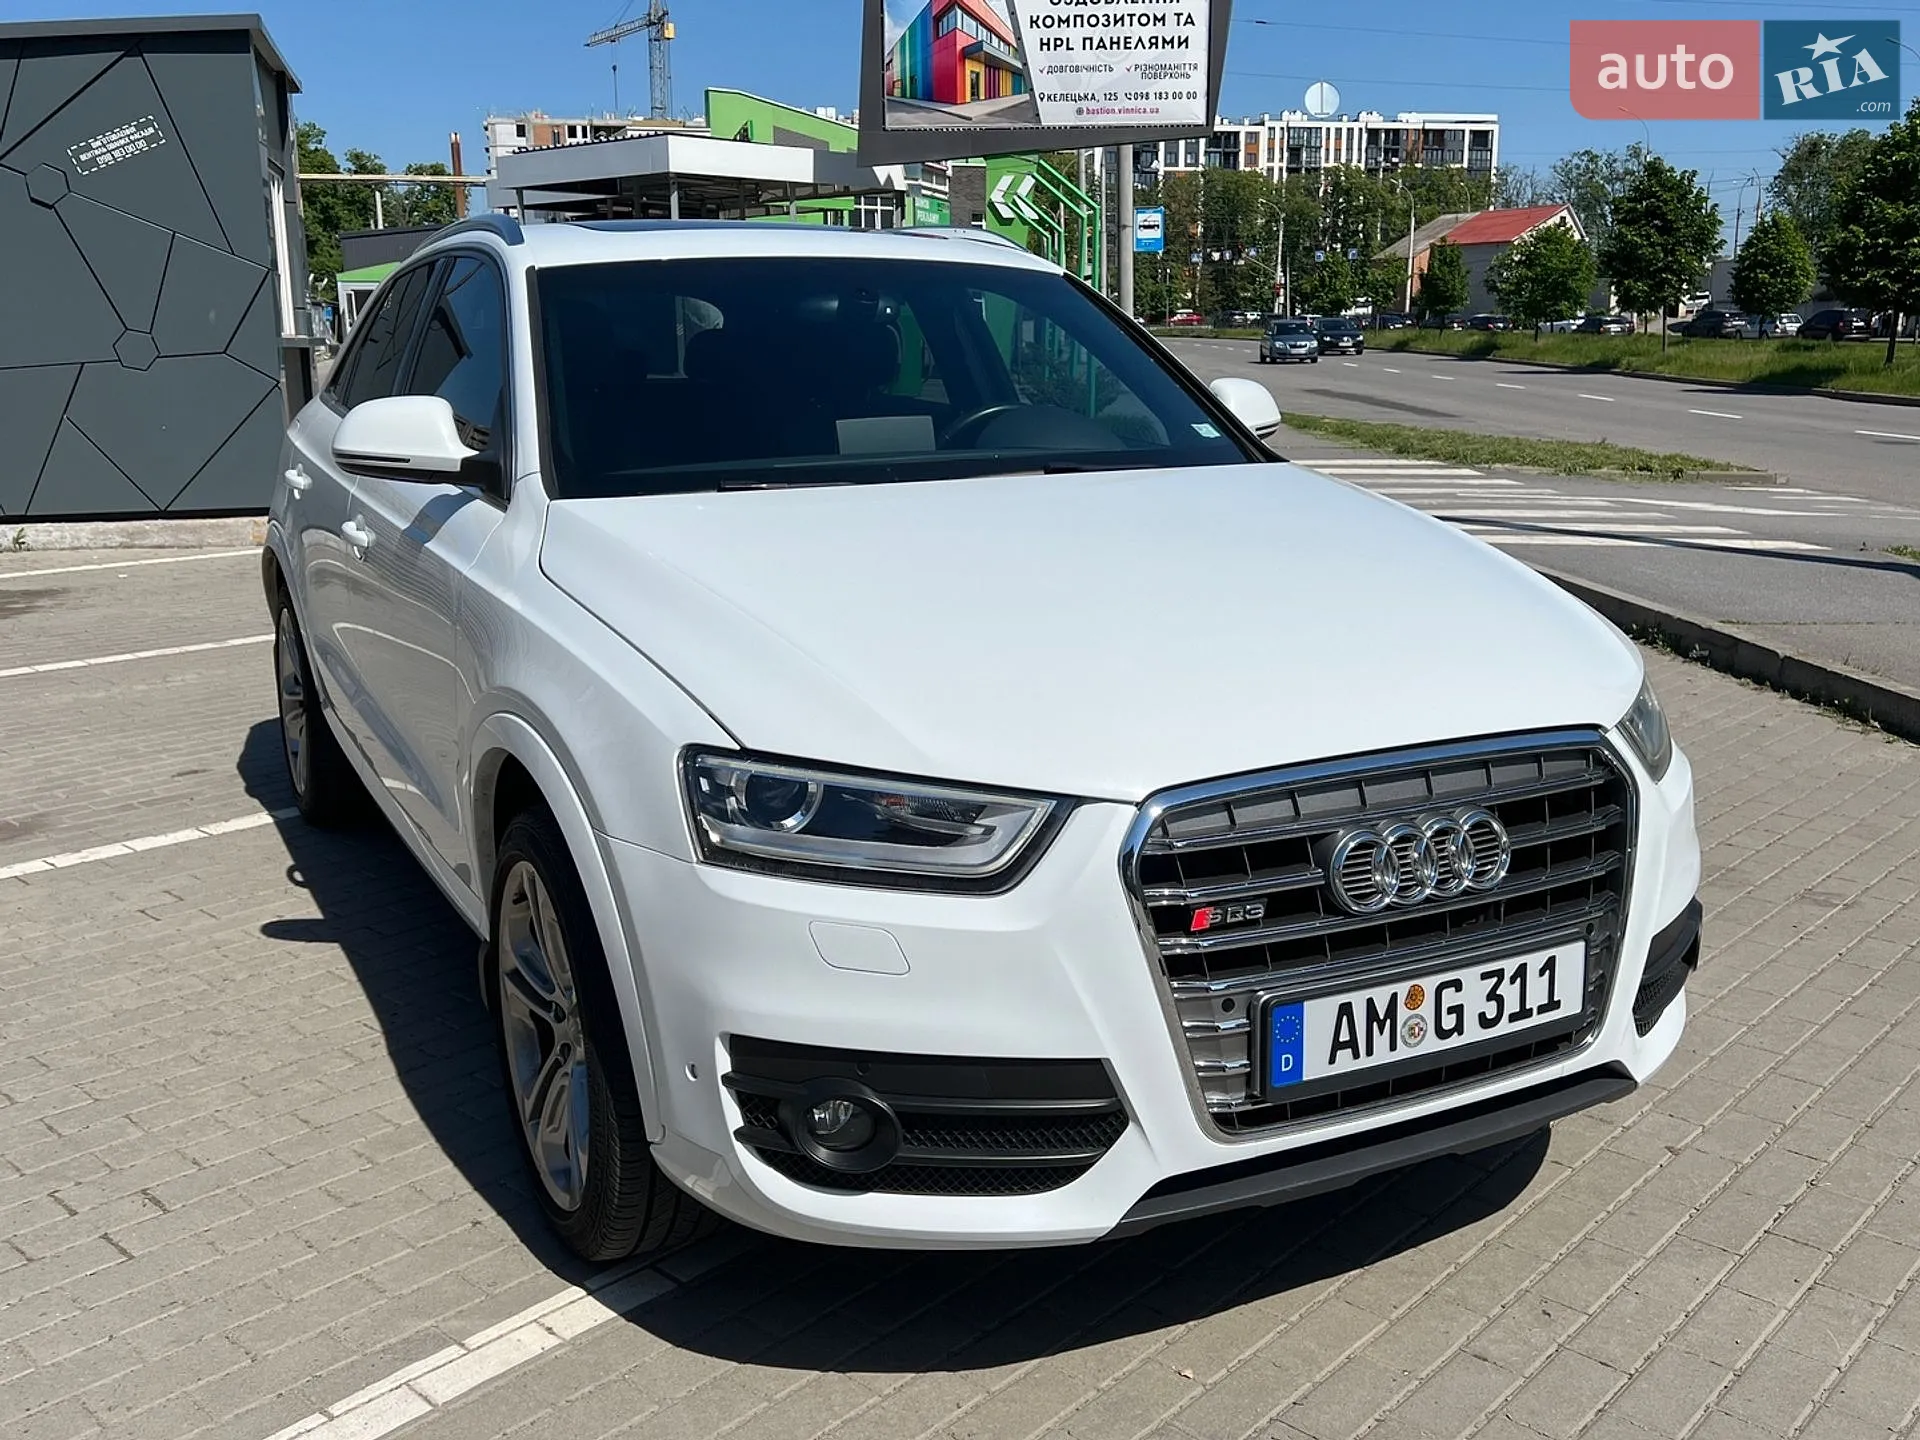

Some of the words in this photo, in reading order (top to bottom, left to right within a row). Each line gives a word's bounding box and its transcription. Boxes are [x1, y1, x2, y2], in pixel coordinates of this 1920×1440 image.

[1029, 12, 1167, 29] КОМПОЗИТОМ
[1174, 12, 1196, 27] ТА
[1039, 37, 1075, 51] HPL
[1082, 35, 1190, 51] ПАНЕЛЯМИ
[1046, 64, 1115, 74] ДОВГОВІЧНІСТЬ
[1133, 63, 1199, 72] РІЗНОМАНІТТЯ
[1141, 72, 1191, 80] ПОВЕРХОНЬ
[1046, 92, 1100, 103] КЕЛЕЦЬКА,
[1103, 92, 1119, 102] 125
[1133, 91, 1150, 101] 098
[1154, 91, 1169, 100] 183
[1172, 91, 1183, 100] 00
[1186, 91, 1198, 100] 00
[1085, 106, 1160, 116] bastion.vinnica.ua
[1328, 992, 1398, 1066] AM
[1435, 978, 1464, 1041] G
[1478, 955, 1562, 1030] 311
[1281, 1054, 1293, 1073] D
